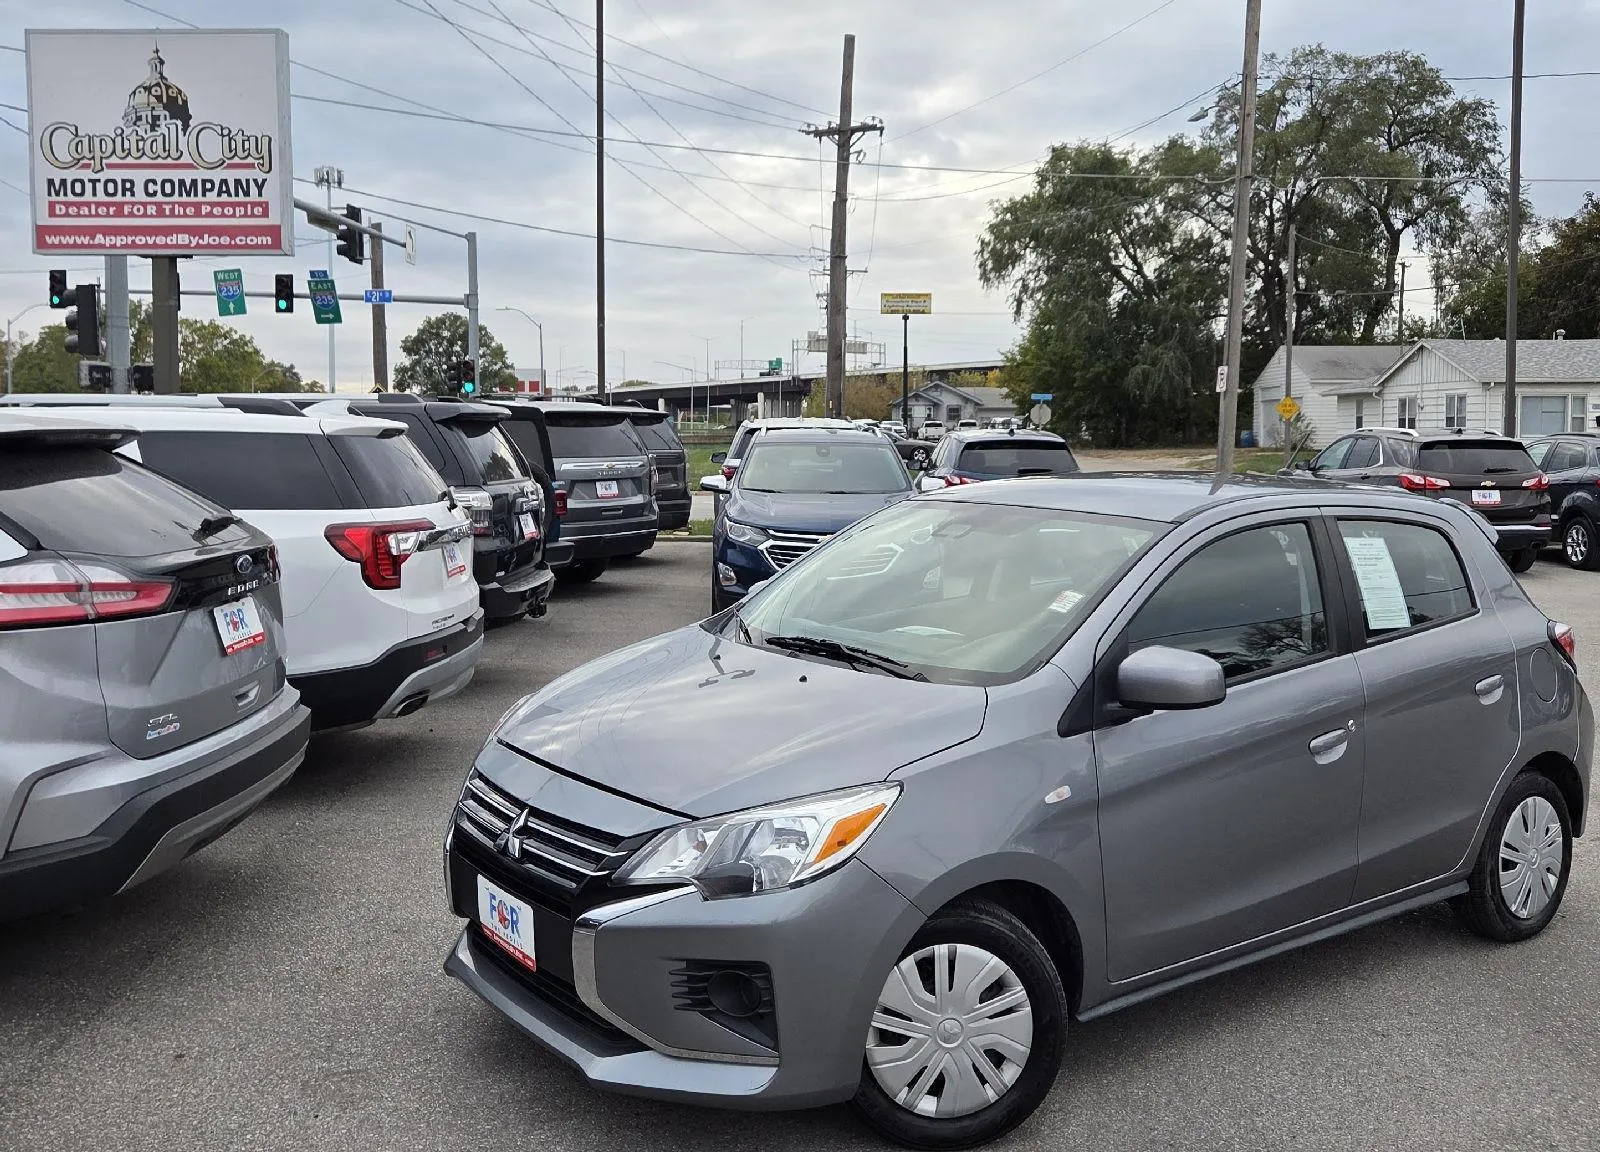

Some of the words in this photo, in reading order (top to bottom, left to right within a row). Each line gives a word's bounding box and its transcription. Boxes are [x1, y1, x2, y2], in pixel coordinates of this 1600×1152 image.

[40, 121, 183, 173] Capital
[187, 121, 272, 173] City
[46, 178, 136, 198] MOTOR
[143, 178, 268, 198] COMPANY
[55, 203, 117, 216] Dealer
[123, 203, 157, 216] FOR
[162, 203, 195, 216] The
[202, 203, 264, 218] People
[45, 233, 272, 247] www.ApprovedByJoe.com
[220, 286, 240, 297] 235
[315, 293, 335, 305] 235
